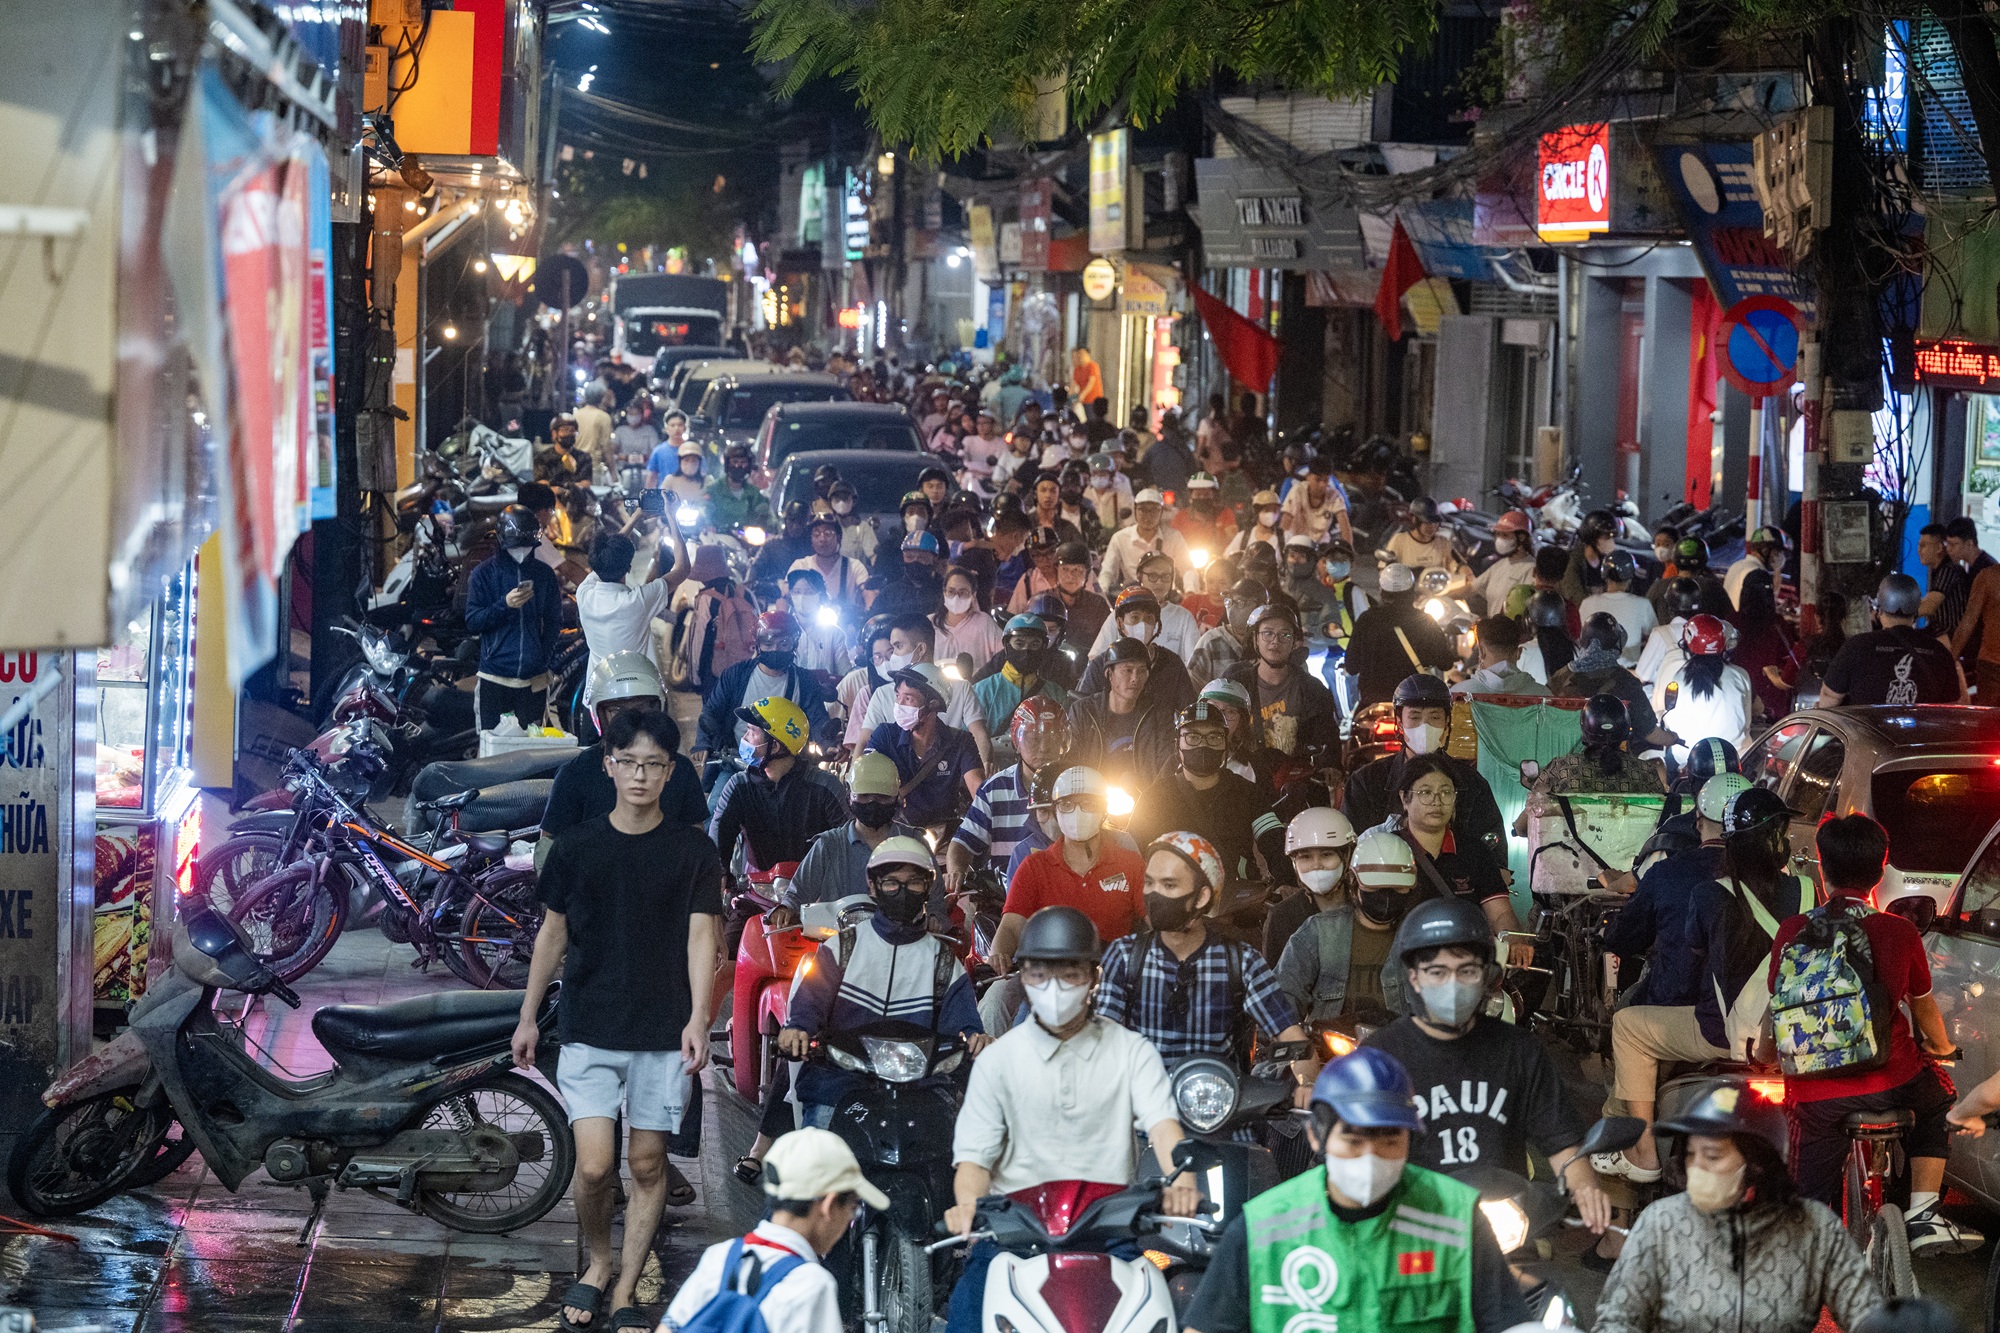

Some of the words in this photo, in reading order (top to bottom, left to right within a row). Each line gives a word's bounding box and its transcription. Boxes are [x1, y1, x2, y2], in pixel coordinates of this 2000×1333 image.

[1543, 161, 1586, 200] CIRCLE
[1235, 197, 1261, 225] THE
[1262, 197, 1302, 225] NIGHT
[364, 853, 412, 907] DRAGON
[1903, 876, 1953, 888] morning
[1438, 1126, 1480, 1165] 18
